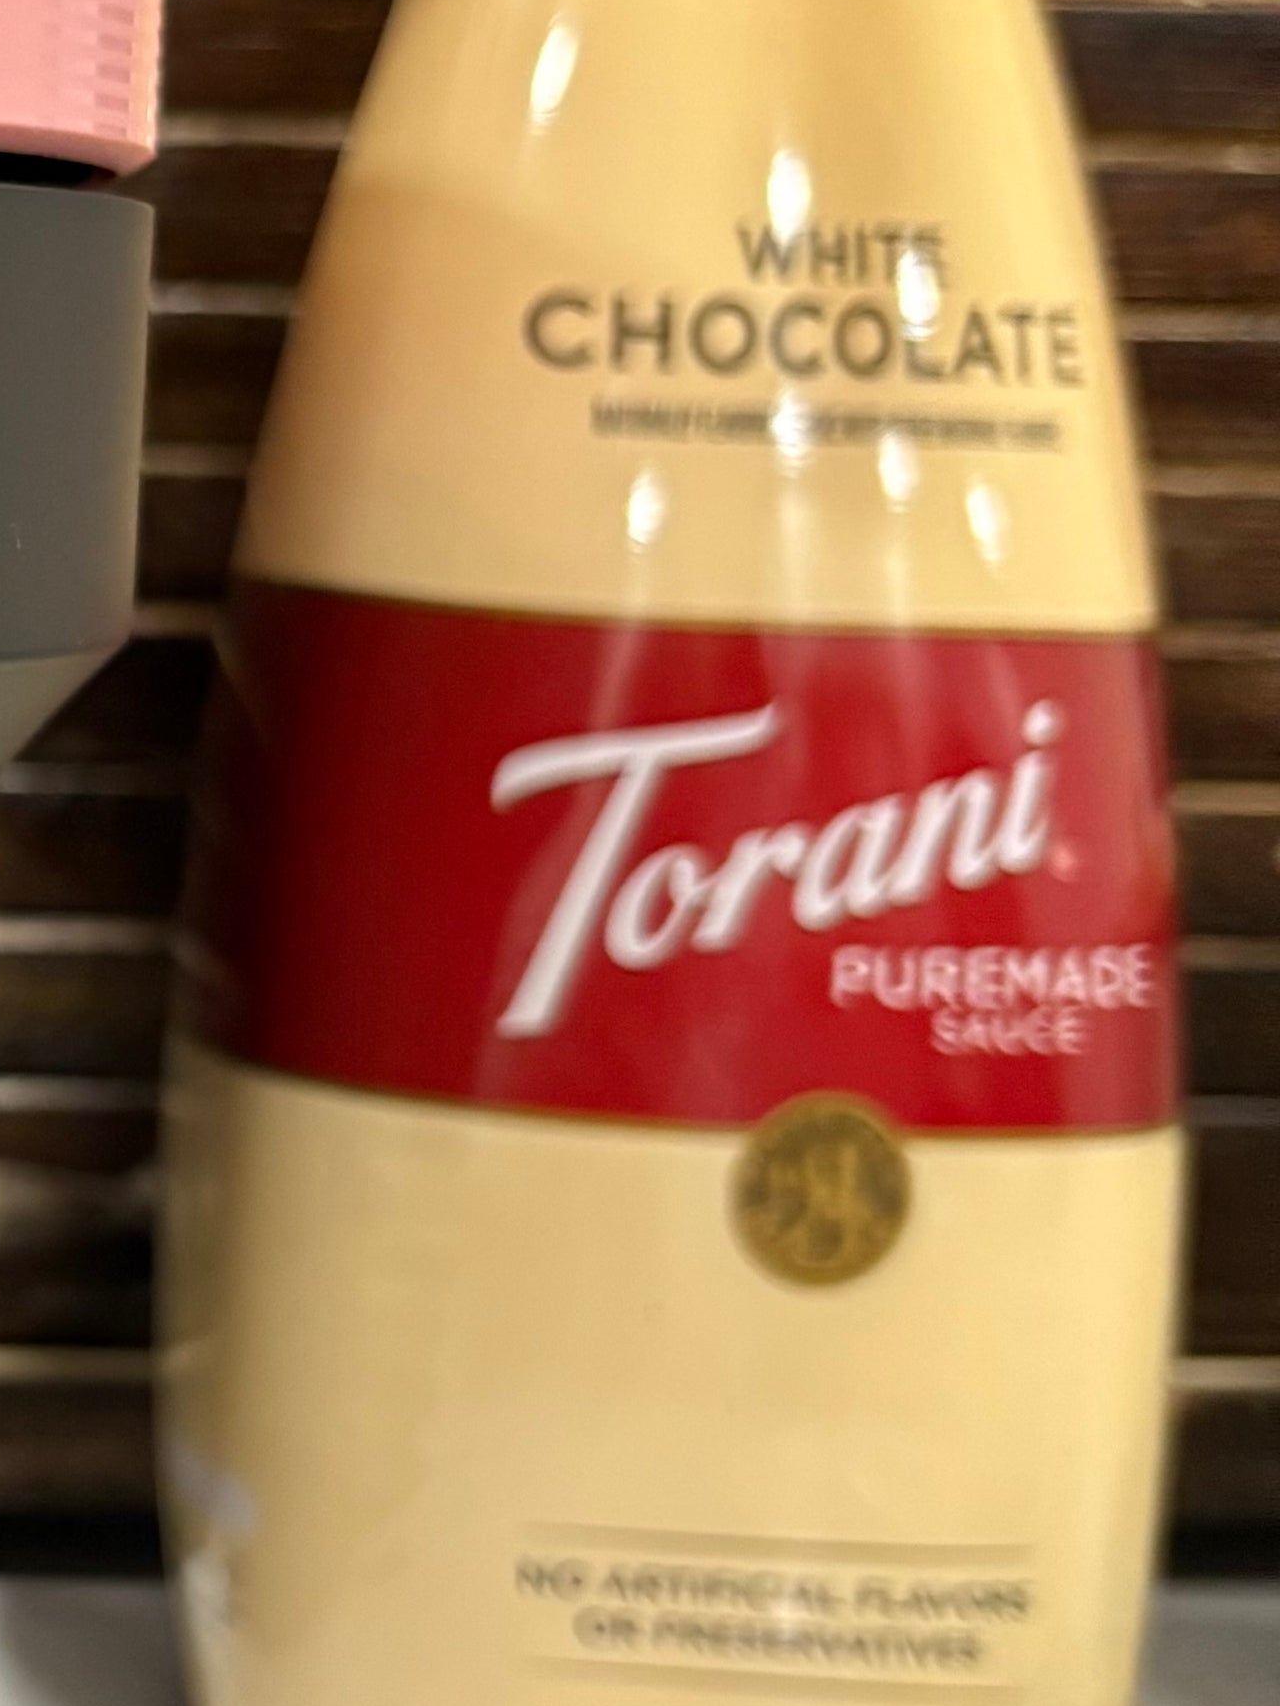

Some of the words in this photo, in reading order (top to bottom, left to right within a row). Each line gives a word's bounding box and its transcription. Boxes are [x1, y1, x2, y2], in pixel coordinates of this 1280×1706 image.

[522, 287, 1083, 385] CHOCOLATE
[490, 701, 1062, 1043] Torani
[831, 943, 1156, 1011] PUREMADE
[931, 1003, 1086, 1057] SAUCE
[514, 1555, 592, 1601] NO
[852, 1576, 1032, 1625] FLAVORS
[571, 1604, 644, 1649] OR
[649, 1608, 987, 1671] PRESERVATIVES
